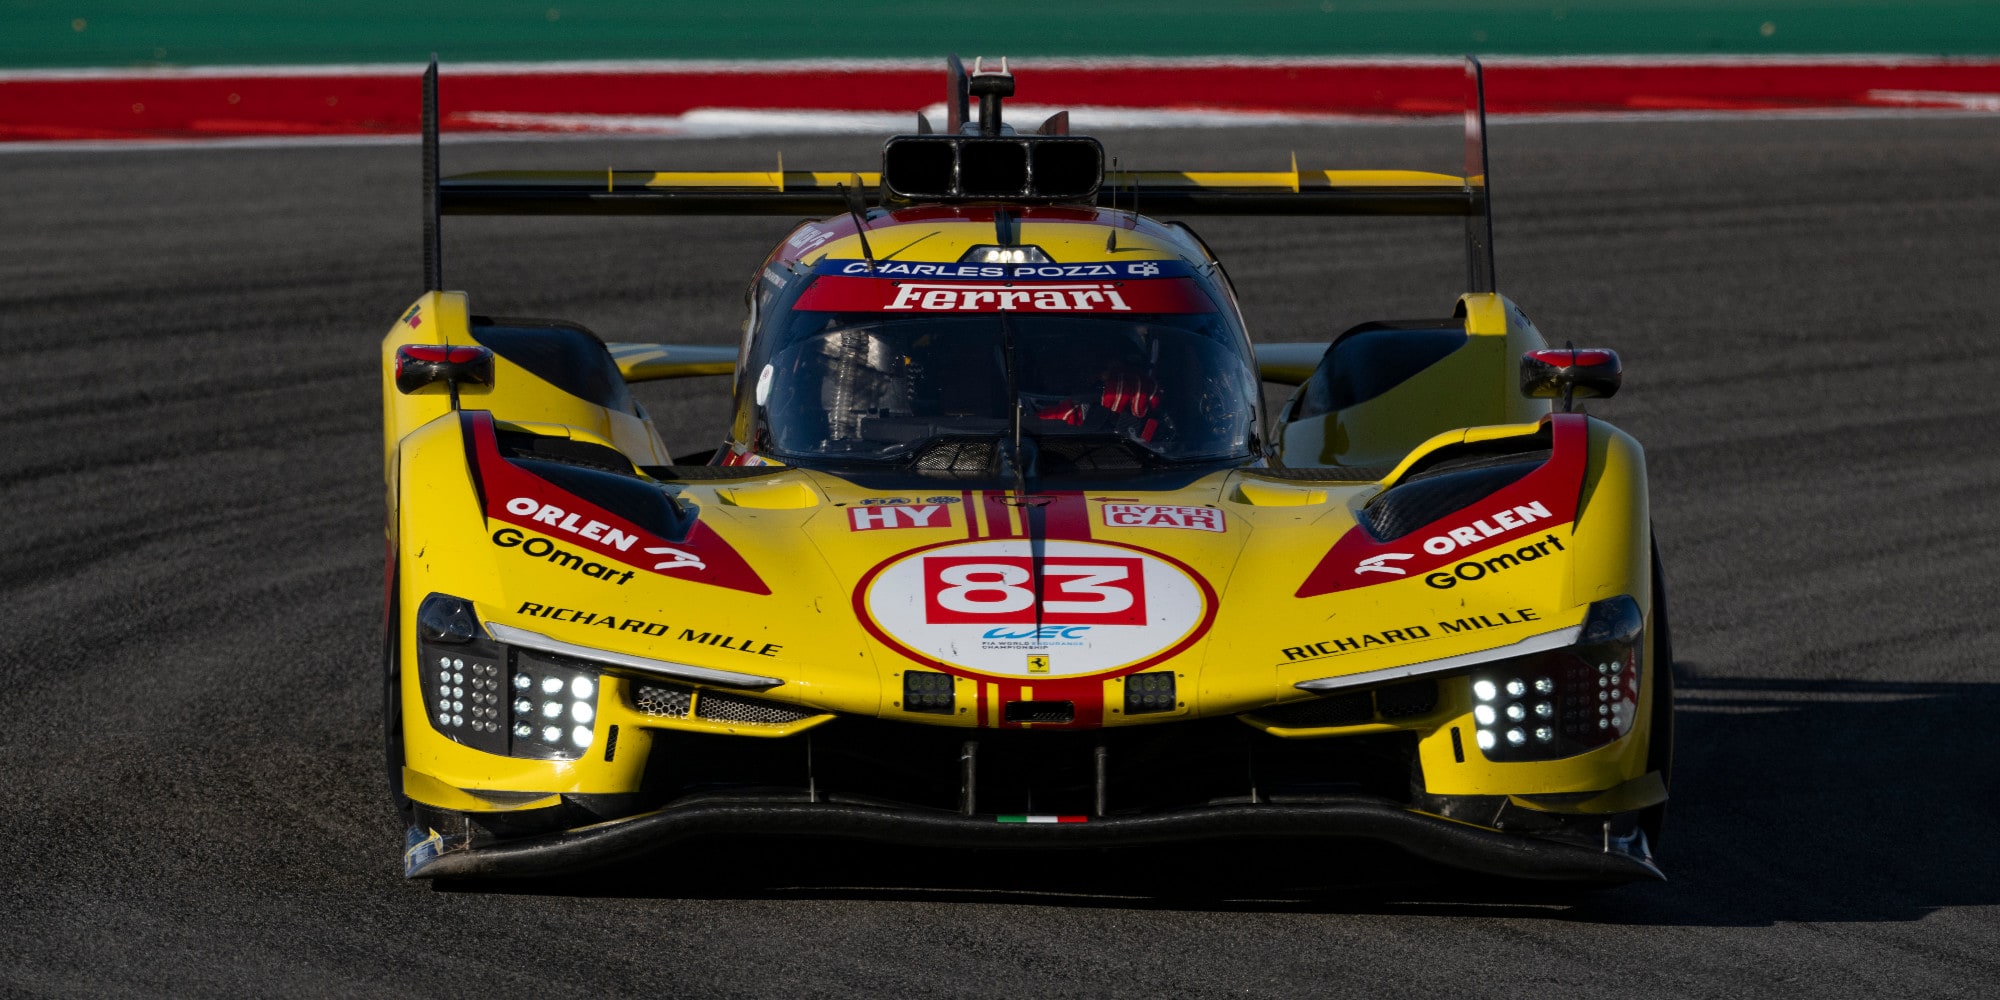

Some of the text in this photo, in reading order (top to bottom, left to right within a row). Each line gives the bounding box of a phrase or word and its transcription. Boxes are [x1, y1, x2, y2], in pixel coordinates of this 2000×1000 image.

[842, 262, 1117, 277] CHARLES POZZI
[883, 283, 1132, 310] Ferrari
[506, 497, 639, 552] ORLEN
[853, 505, 940, 529] HY
[1111, 505, 1214, 516] HYPER
[1113, 512, 1216, 529] CAR
[1423, 500, 1553, 555] ORLEN
[492, 528, 635, 585] GOmart
[1424, 533, 1566, 589] GOmart
[936, 564, 1134, 614] 83
[517, 601, 783, 657] RICHARD MILLE
[982, 625, 1092, 639] WEC
[1281, 608, 1541, 660] RICHARD MILLE
